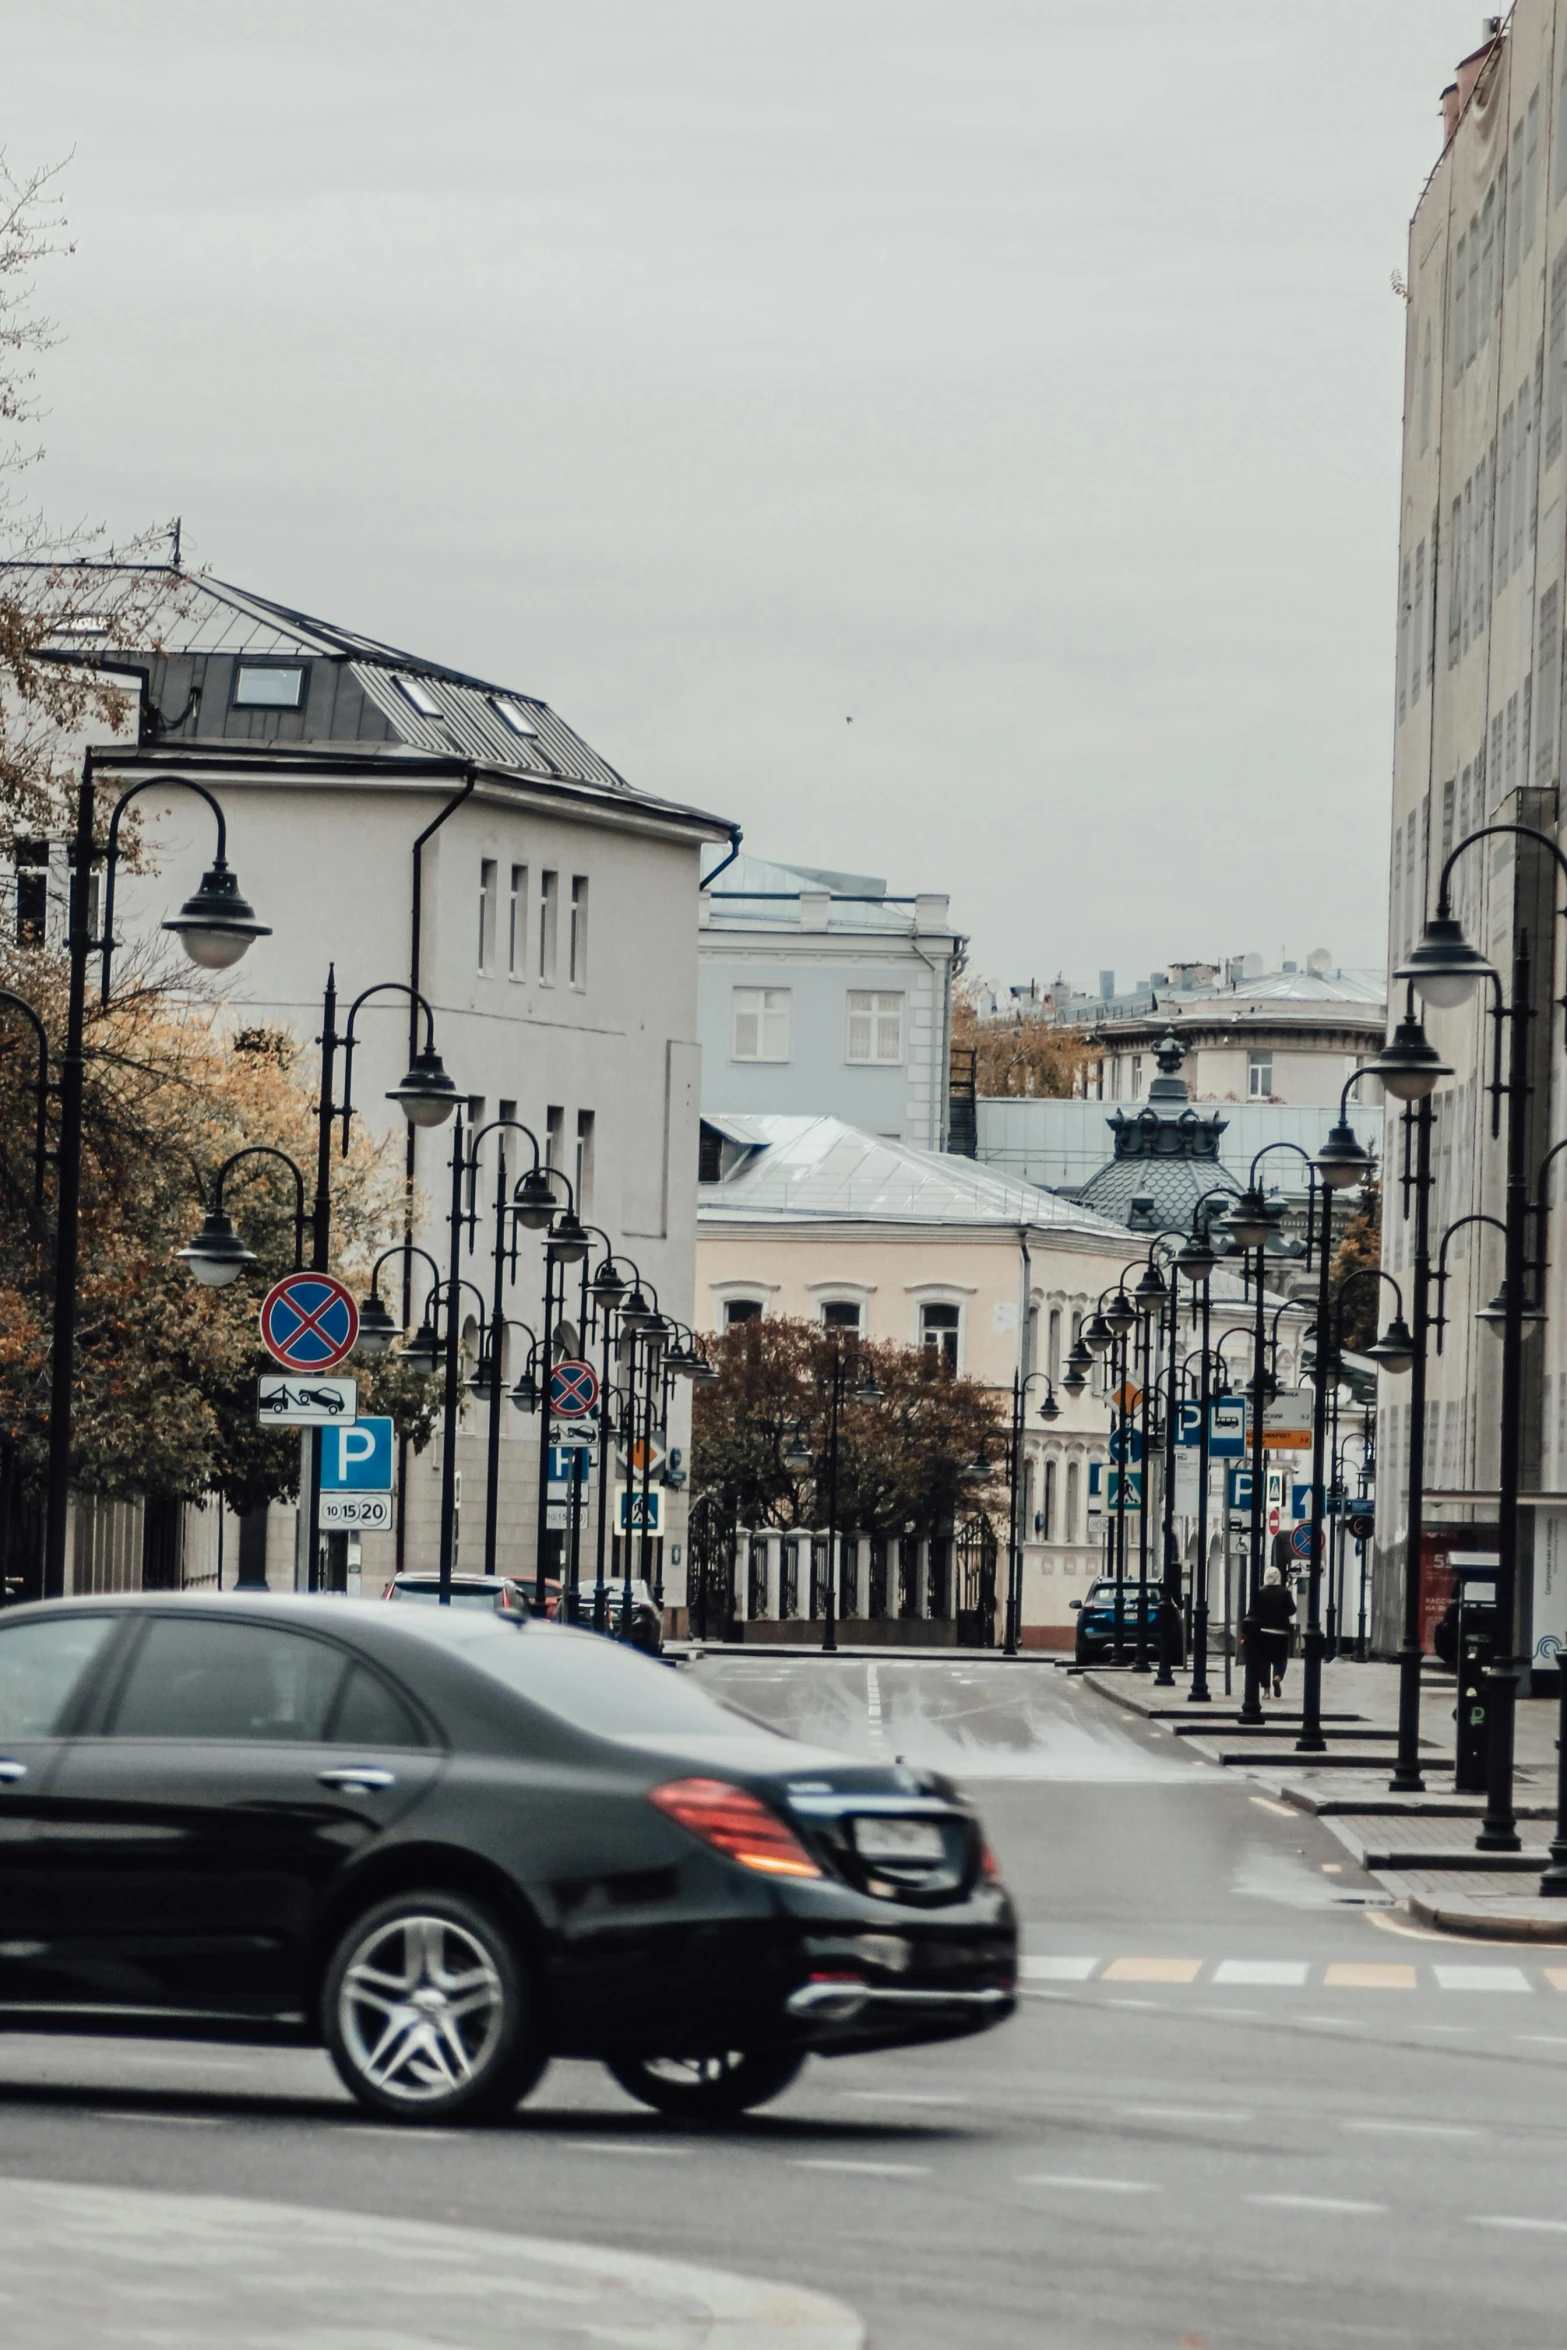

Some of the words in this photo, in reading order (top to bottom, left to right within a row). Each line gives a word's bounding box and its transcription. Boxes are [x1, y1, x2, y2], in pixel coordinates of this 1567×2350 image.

[1178, 1405, 1201, 1440] P
[338, 1427, 376, 1481] P
[1235, 1474, 1253, 1505] P
[327, 1506, 338, 1516] 10
[343, 1505, 356, 1518] 15
[361, 1504, 383, 1519] 20
